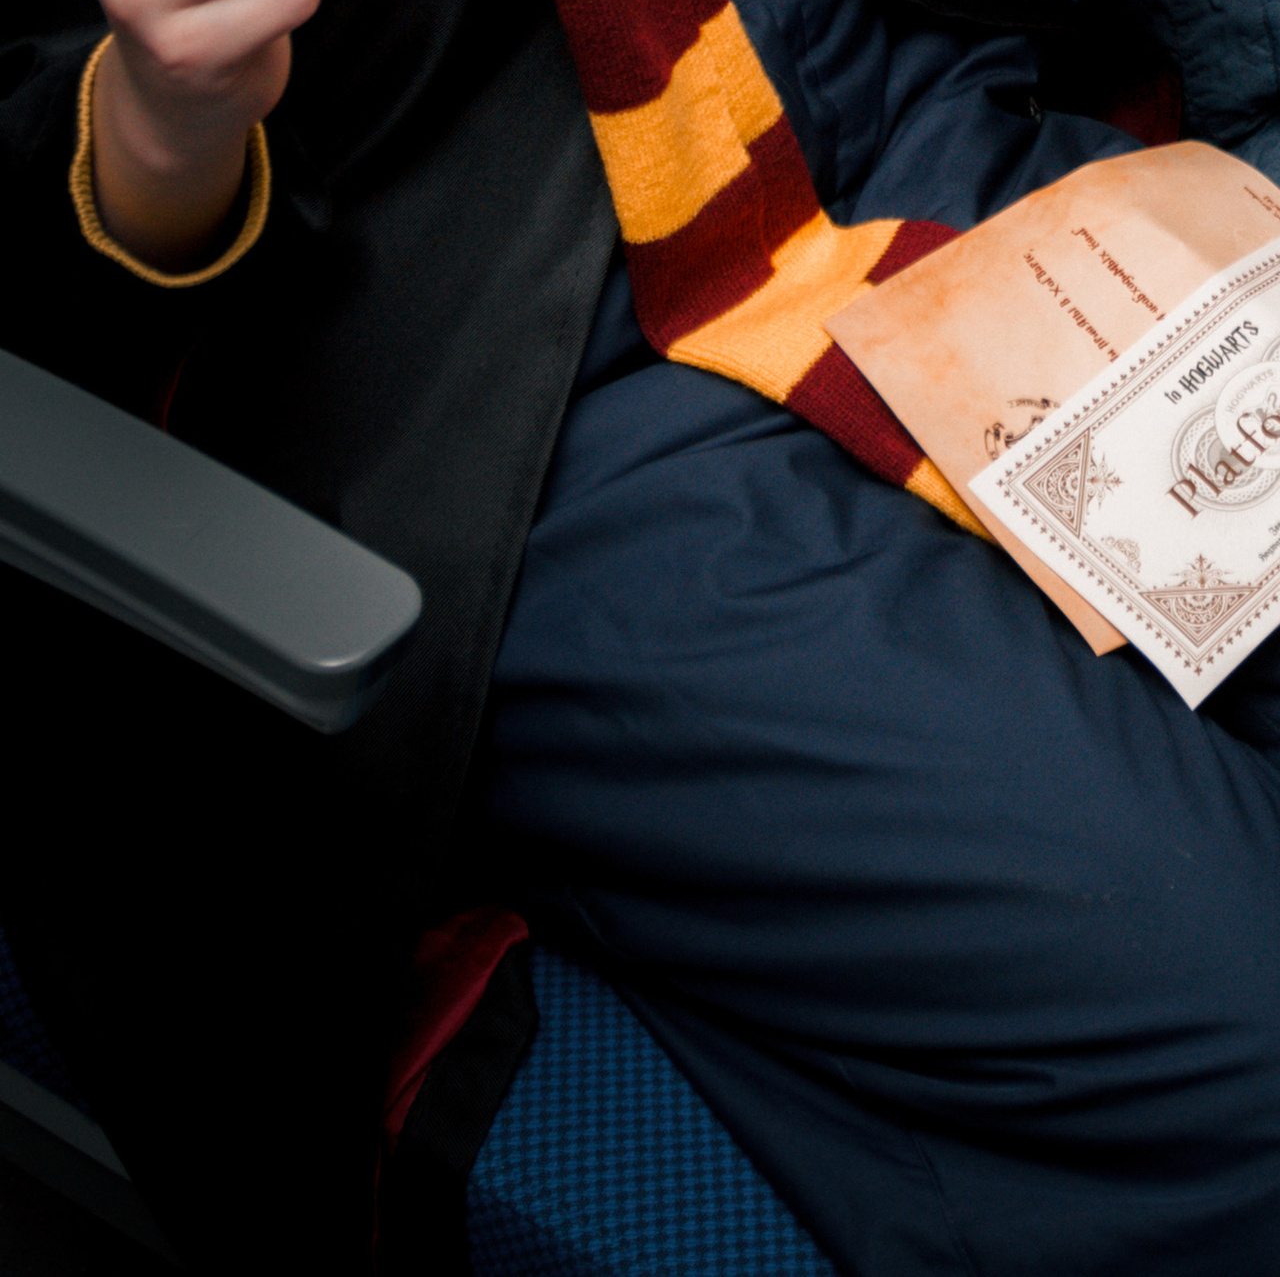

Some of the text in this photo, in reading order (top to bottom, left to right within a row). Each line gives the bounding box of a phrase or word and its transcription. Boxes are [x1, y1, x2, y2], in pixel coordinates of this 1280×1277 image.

[1164, 320, 1259, 405] to HOGWARTS
[1226, 369, 1274, 414] HOGWARTS
